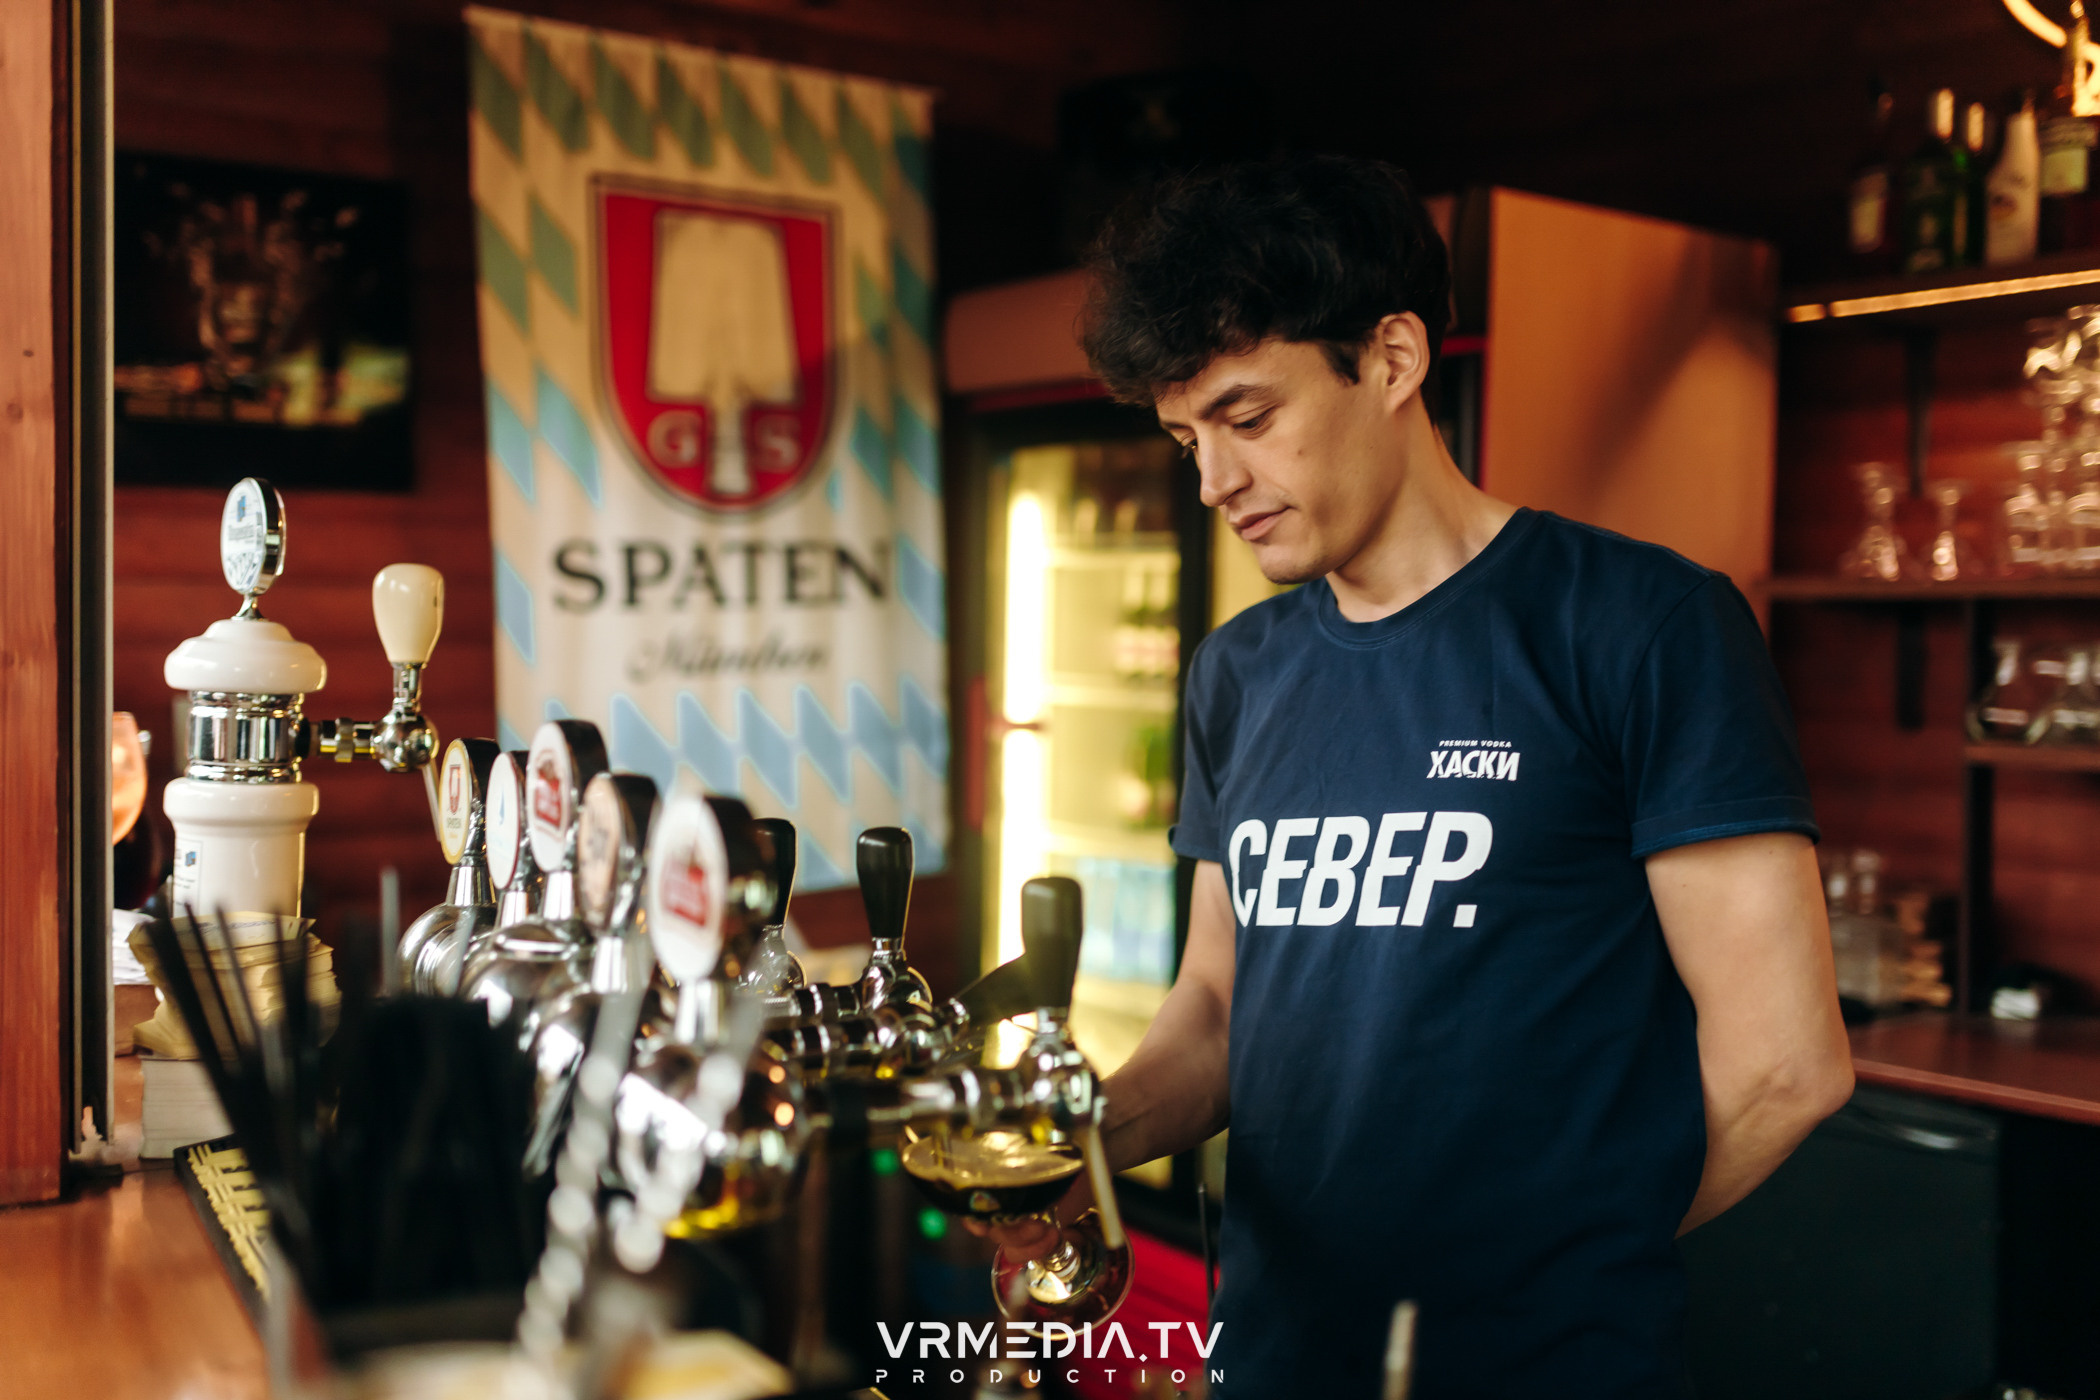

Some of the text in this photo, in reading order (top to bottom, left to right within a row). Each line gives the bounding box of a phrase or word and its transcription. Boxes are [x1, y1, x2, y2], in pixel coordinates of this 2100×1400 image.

[647, 409, 801, 473] G S
[553, 537, 891, 613] SPATEN
[1426, 750, 1520, 781] ХАСКИ
[1480, 740, 1512, 748] VODKA
[1228, 811, 1494, 928] СЕВЕР.
